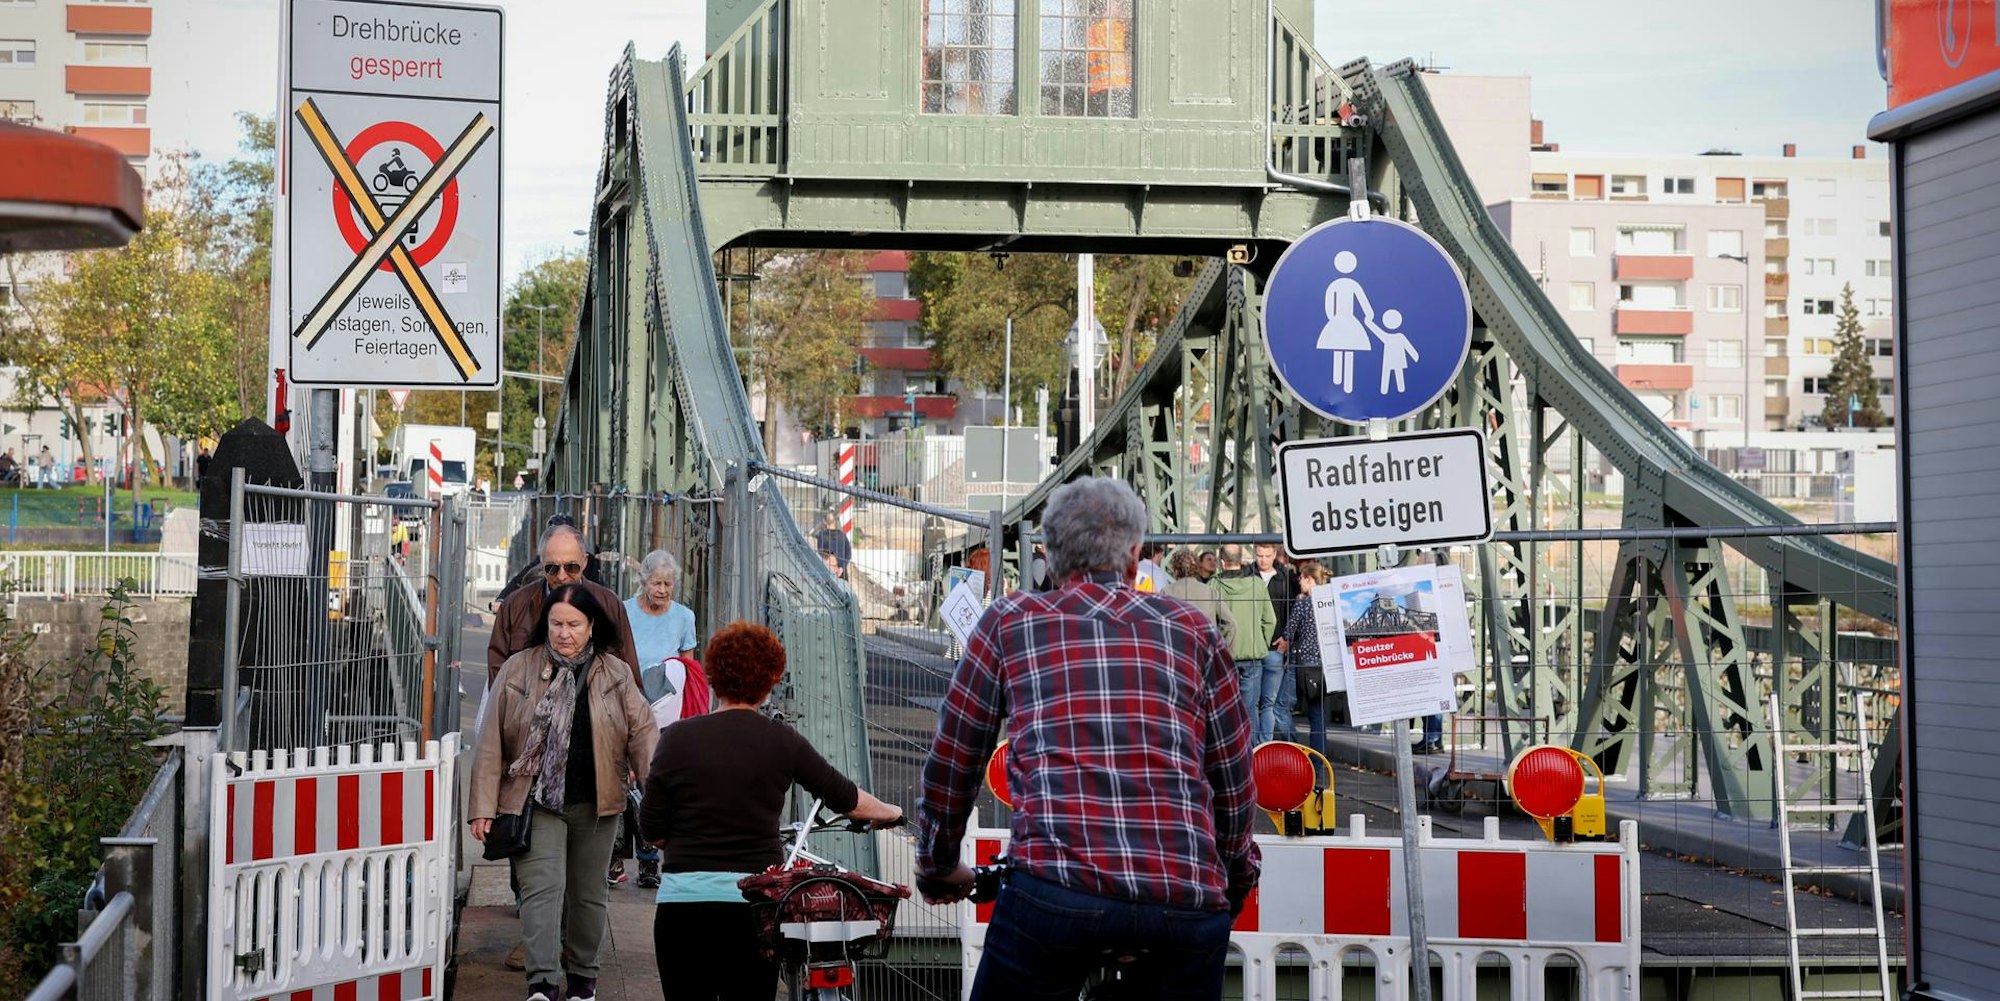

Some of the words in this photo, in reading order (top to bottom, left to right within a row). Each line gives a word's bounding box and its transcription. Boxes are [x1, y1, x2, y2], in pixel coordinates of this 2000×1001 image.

[332, 14, 461, 45] Drehbrücke
[350, 56, 442, 81] gesperrt
[356, 293, 410, 313] jeweils
[401, 316, 489, 336] Songen,
[355, 338, 438, 359] Feiertagen
[1306, 452, 1443, 488] Radfahrer
[1311, 498, 1443, 532] absteigen
[1357, 642, 1395, 654] Deutzer
[1359, 651, 1414, 666] Drehbrücke
